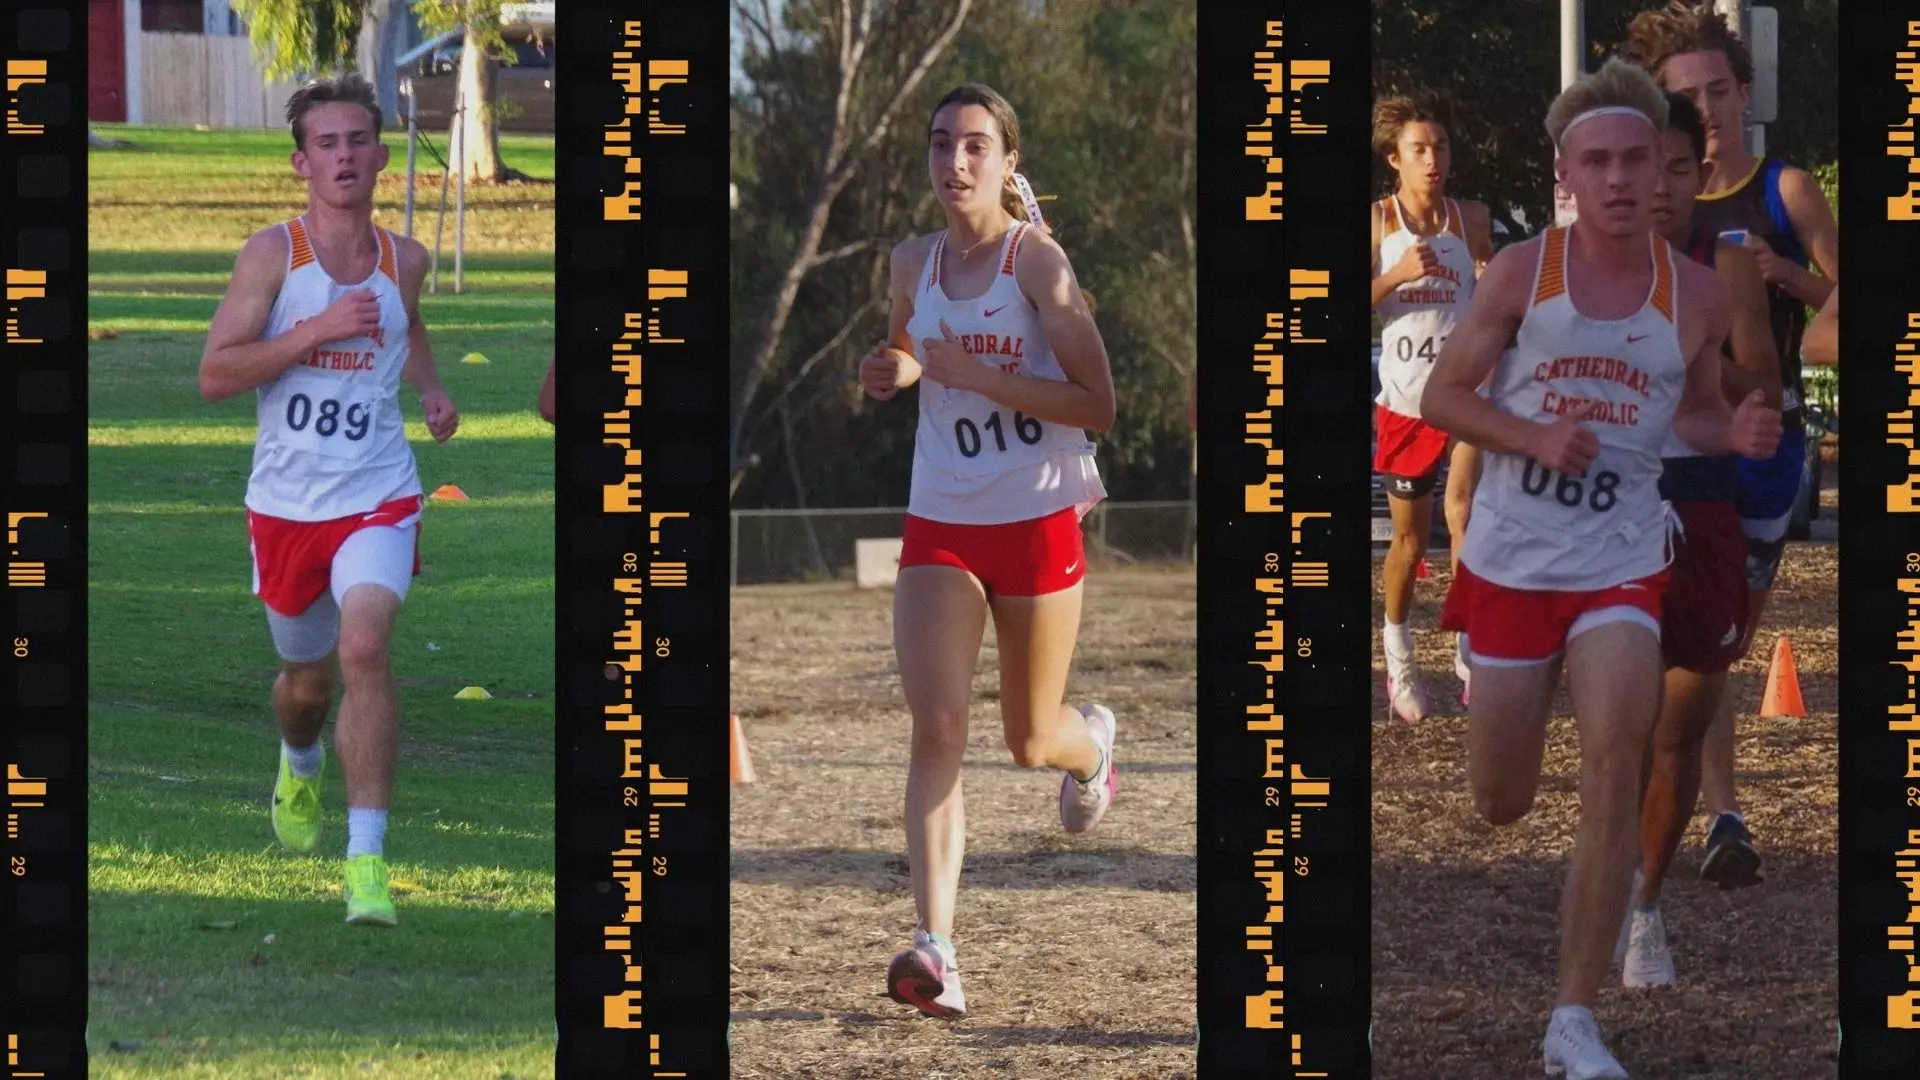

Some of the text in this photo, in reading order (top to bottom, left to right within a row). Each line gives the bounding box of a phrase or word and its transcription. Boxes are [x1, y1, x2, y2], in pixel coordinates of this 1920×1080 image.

[1399, 290, 1457, 304] CATHOLIC
[300, 350, 376, 371] ATHOLIC
[955, 334, 1024, 358] EDRAL
[1396, 335, 1447, 363] 04
[1535, 356, 1649, 396] CATHEDRAL
[286, 393, 372, 441] 089
[954, 411, 1043, 458] 016
[1521, 459, 1621, 512] 068
